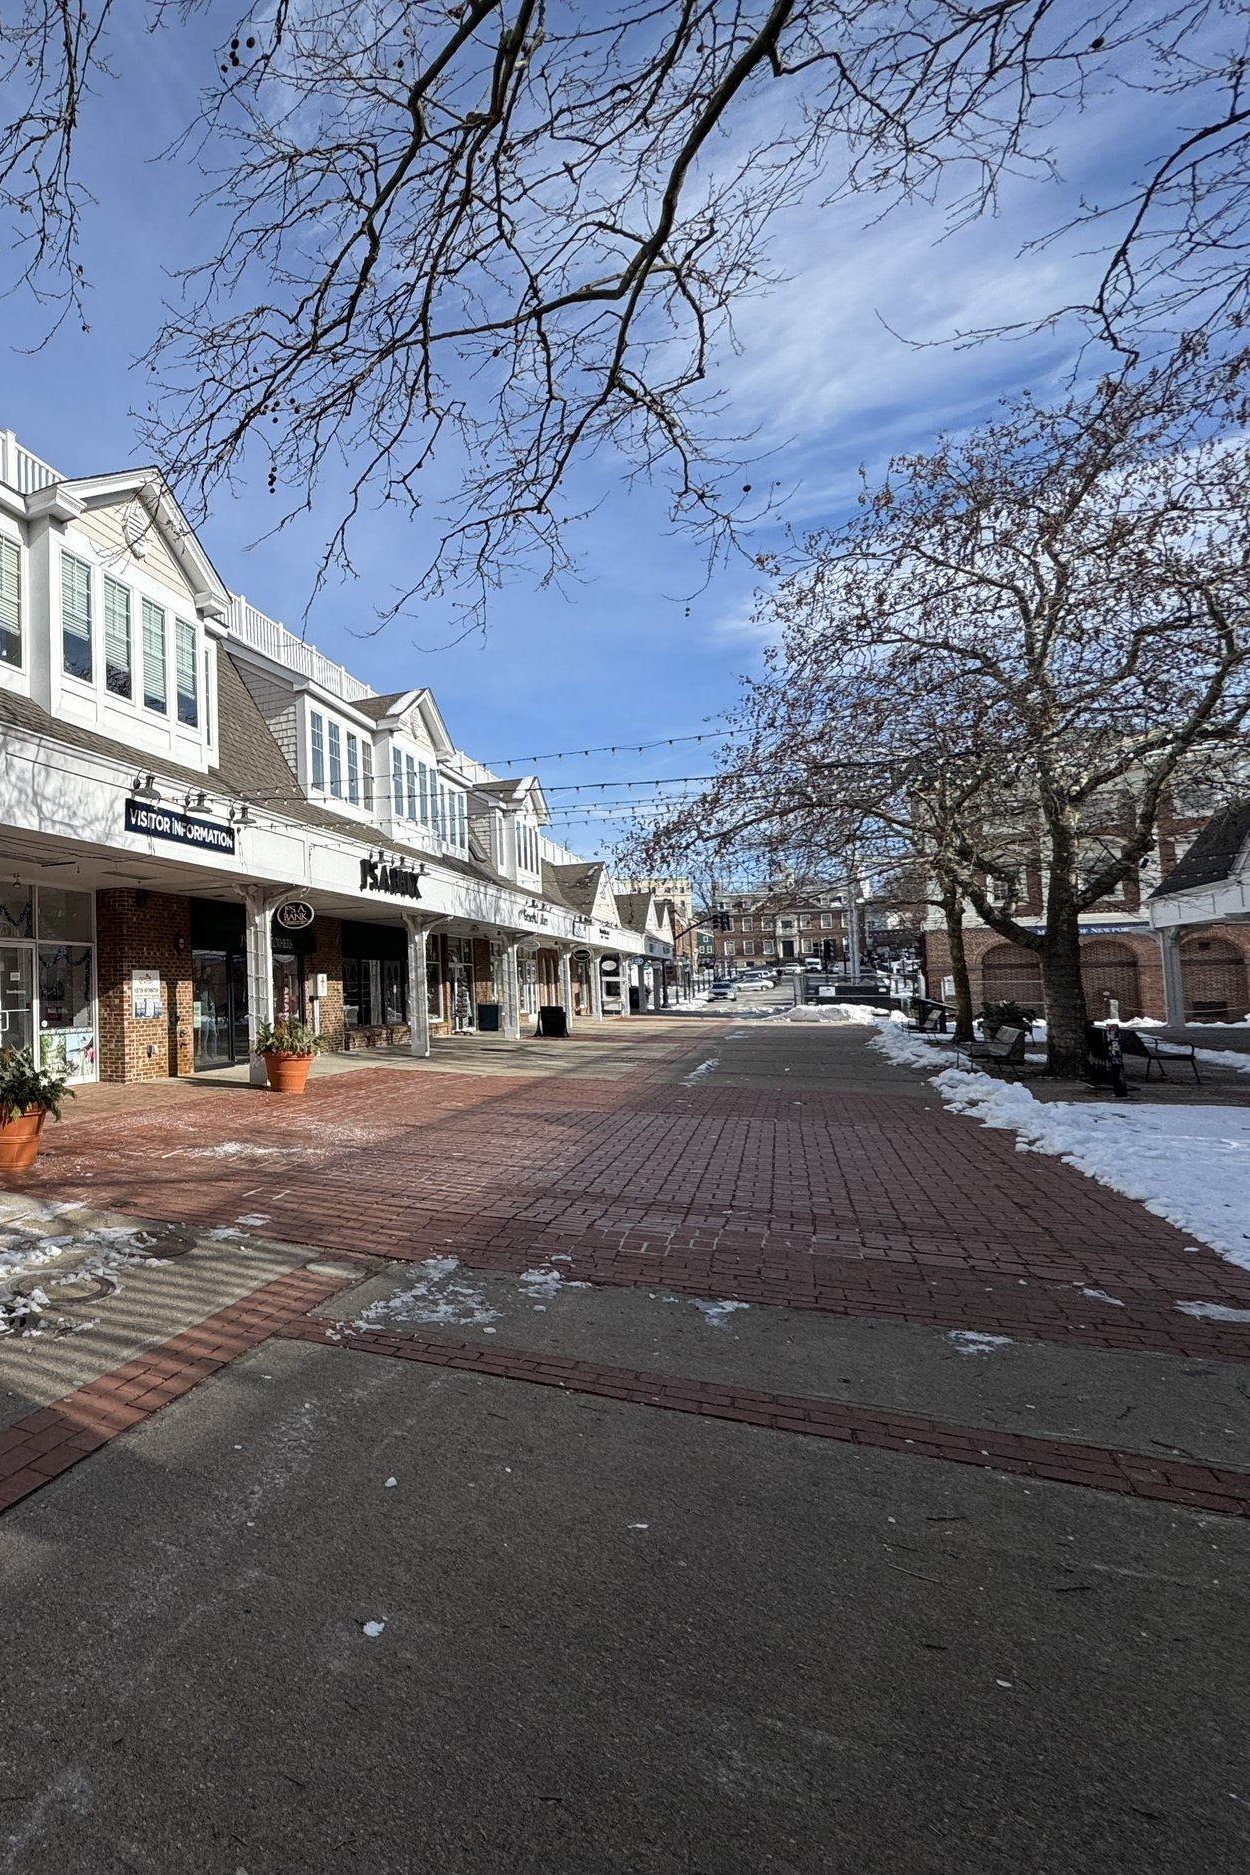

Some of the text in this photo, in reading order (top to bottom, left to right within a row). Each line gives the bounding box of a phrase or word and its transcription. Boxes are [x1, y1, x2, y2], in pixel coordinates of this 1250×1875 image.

[129, 807, 170, 833] VISITOR
[283, 912, 308, 921] BANK
[1090, 926, 1130, 934] NEWPOR
